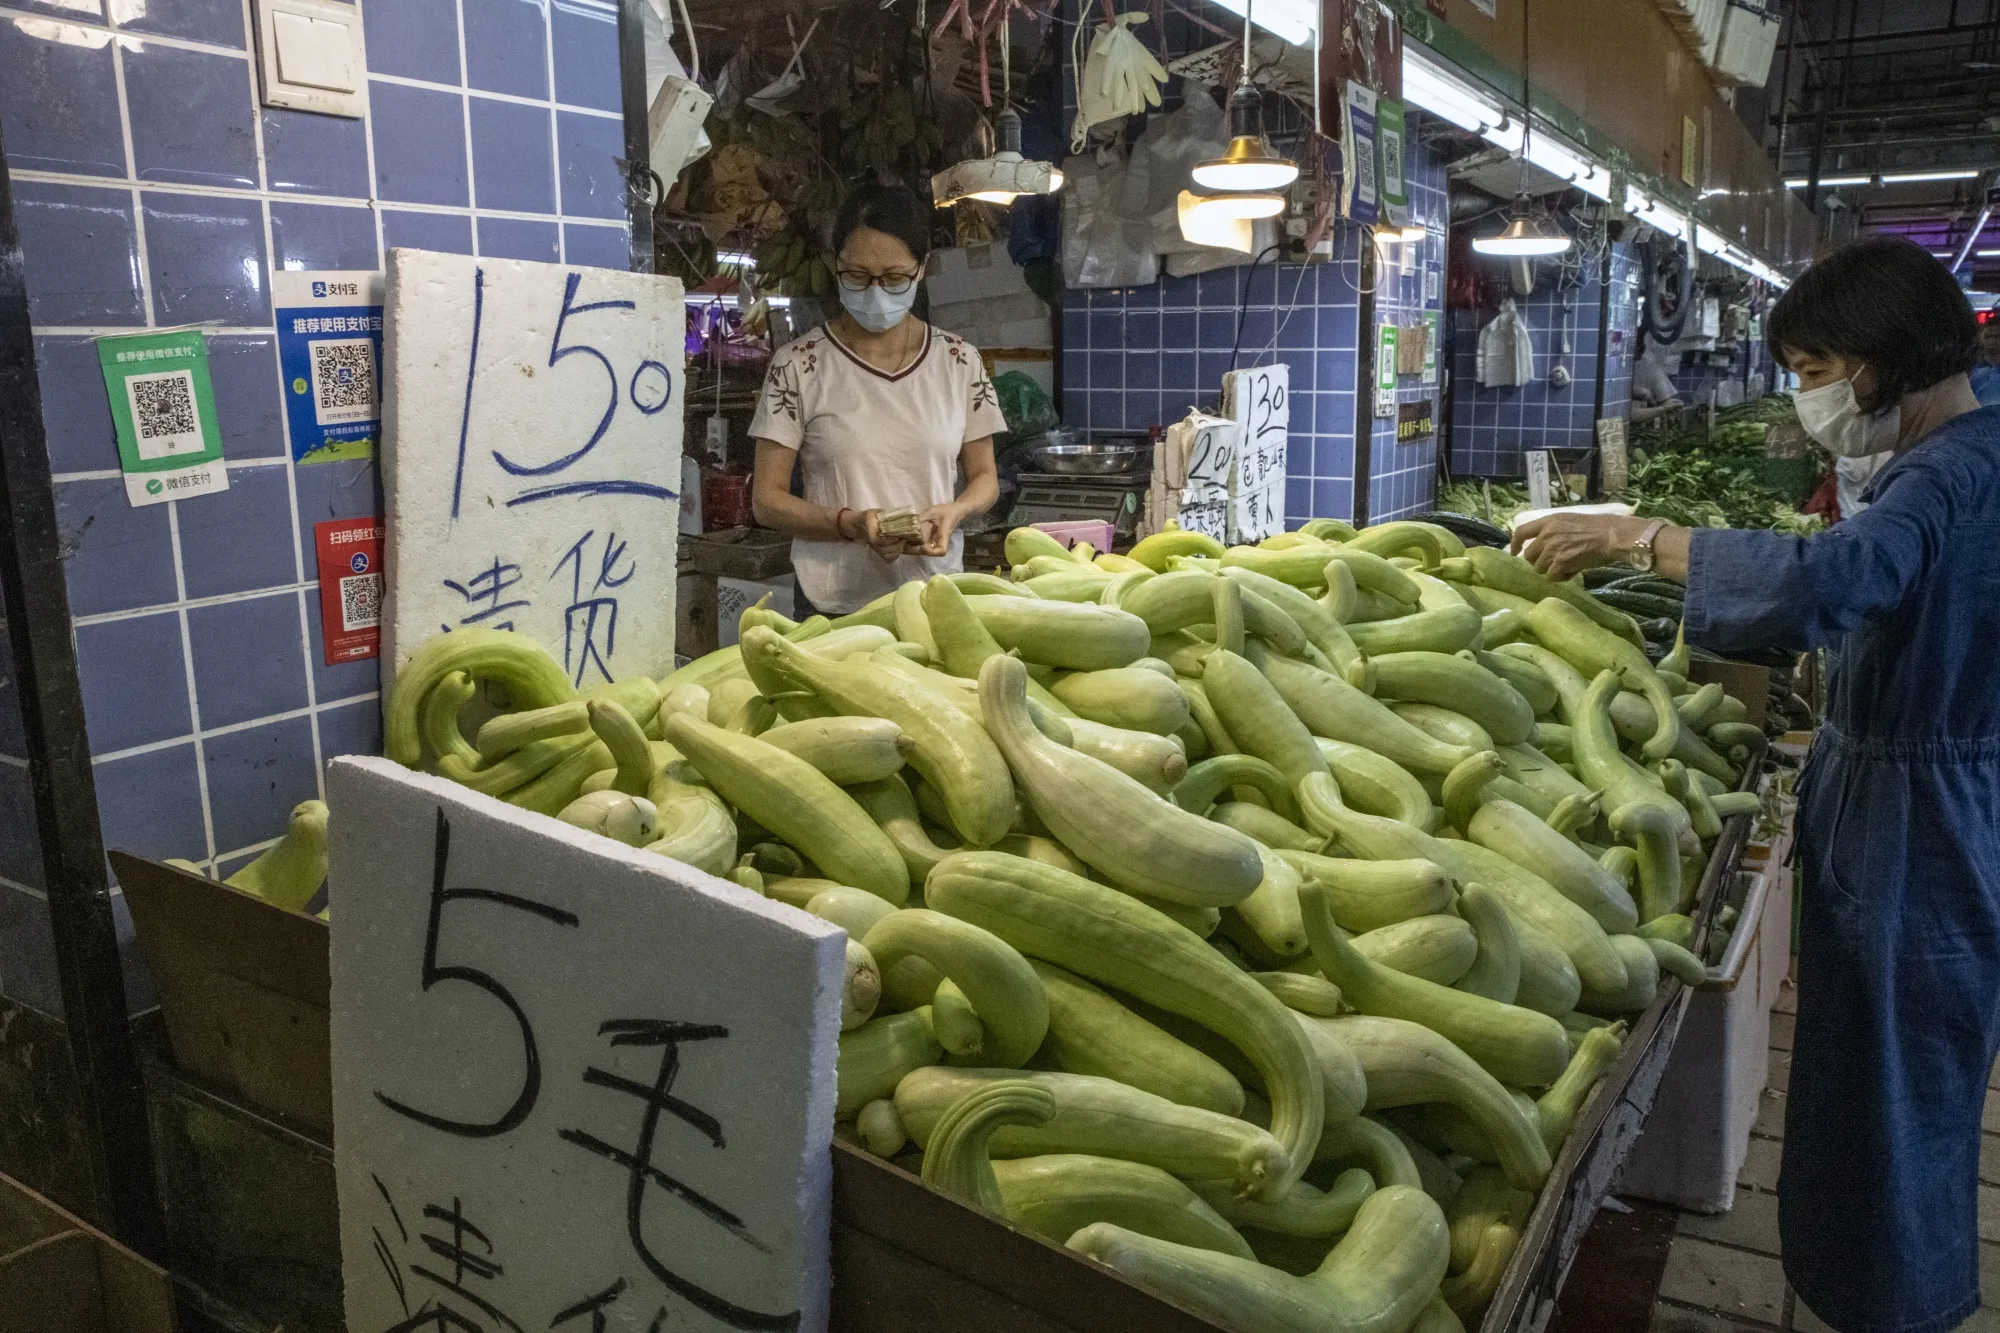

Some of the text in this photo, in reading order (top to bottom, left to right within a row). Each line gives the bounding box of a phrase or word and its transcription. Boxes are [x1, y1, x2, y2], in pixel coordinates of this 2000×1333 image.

[328, 283, 358, 296] 支付宝
[294, 316, 382, 334] 推荐使用支付宝
[116, 347, 193, 363] 推荐使用微信支付
[166, 472, 212, 490] 微信支付
[330, 526, 385, 545] 扫码领红包
